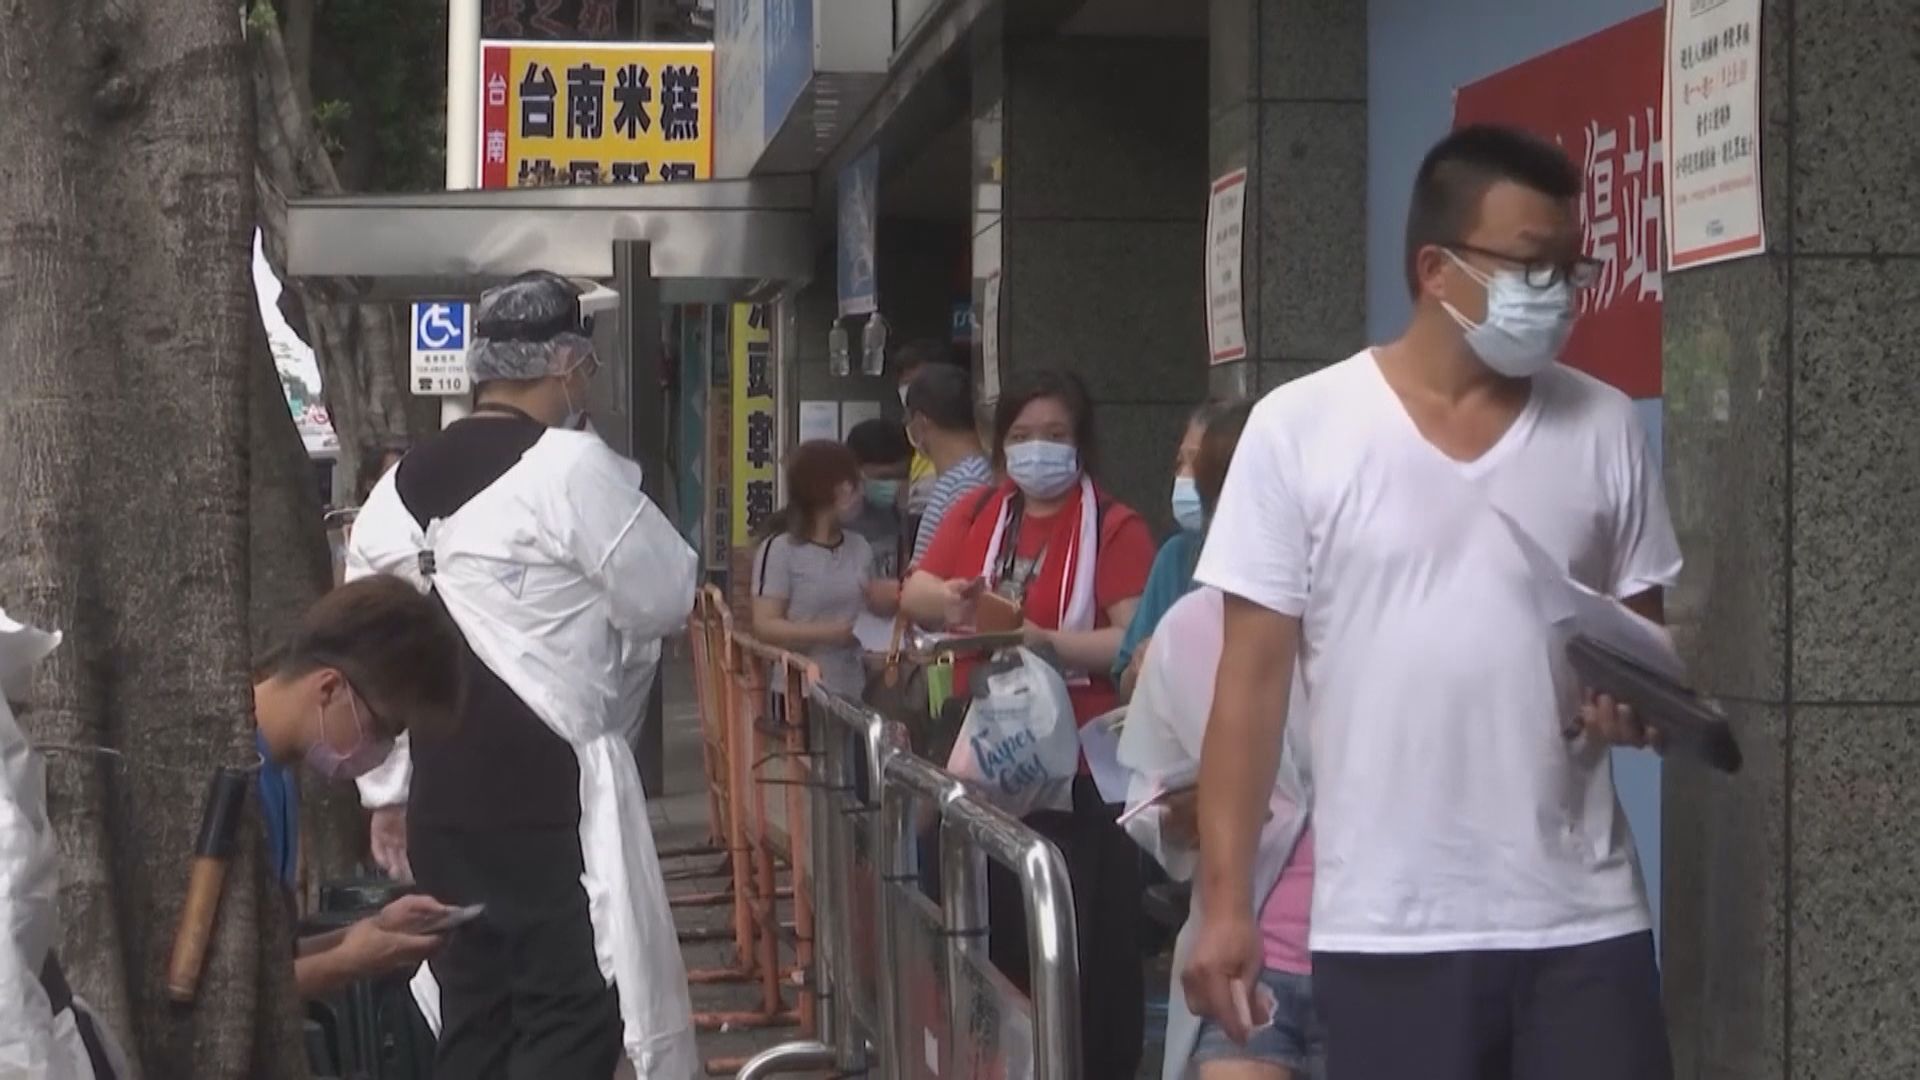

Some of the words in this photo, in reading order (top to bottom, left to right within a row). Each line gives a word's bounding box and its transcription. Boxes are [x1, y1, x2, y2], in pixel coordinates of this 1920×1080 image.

[487, 72, 507, 164] 台南
[519, 62, 699, 140] 台南米糕
[439, 378, 461, 390] 110
[999, 752, 1048, 795] City
